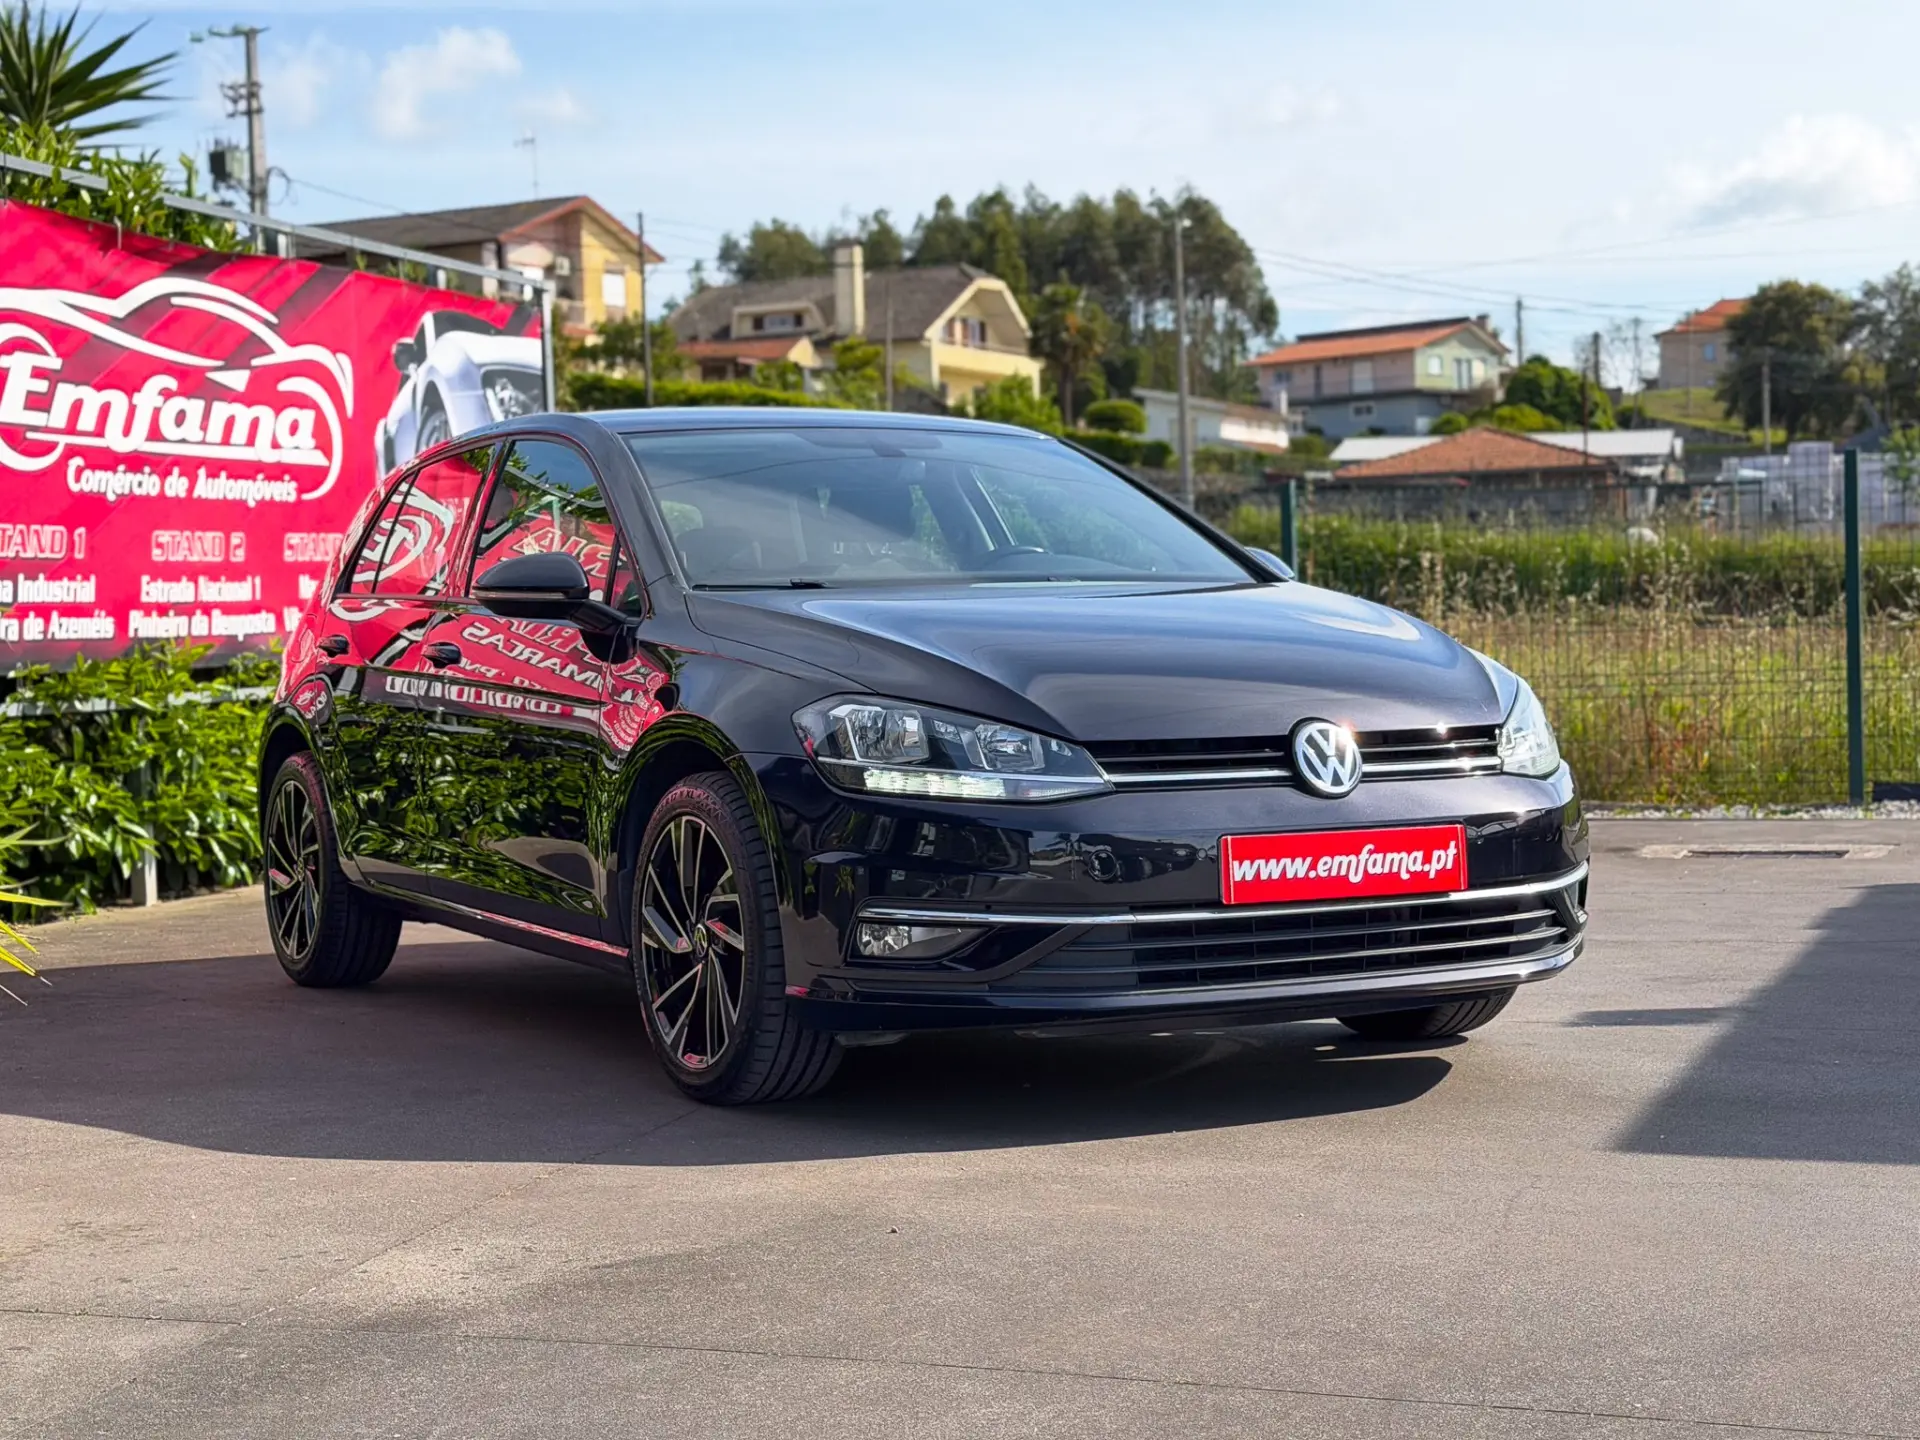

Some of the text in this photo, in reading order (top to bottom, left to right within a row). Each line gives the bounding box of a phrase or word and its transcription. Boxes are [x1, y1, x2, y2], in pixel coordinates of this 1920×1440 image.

[0, 350, 317, 463] Emfama
[67, 456, 298, 508] Comércio de Automóveis
[0, 524, 86, 560] TAND 1
[152, 530, 246, 562] STAND 2
[17, 573, 96, 603] Industrial
[140, 574, 196, 603] Estrada
[23, 611, 44, 641] de
[47, 609, 115, 640] Azeméis
[129, 609, 189, 638] Pinheiro
[1232, 841, 1458, 883] www.emfama.pt
